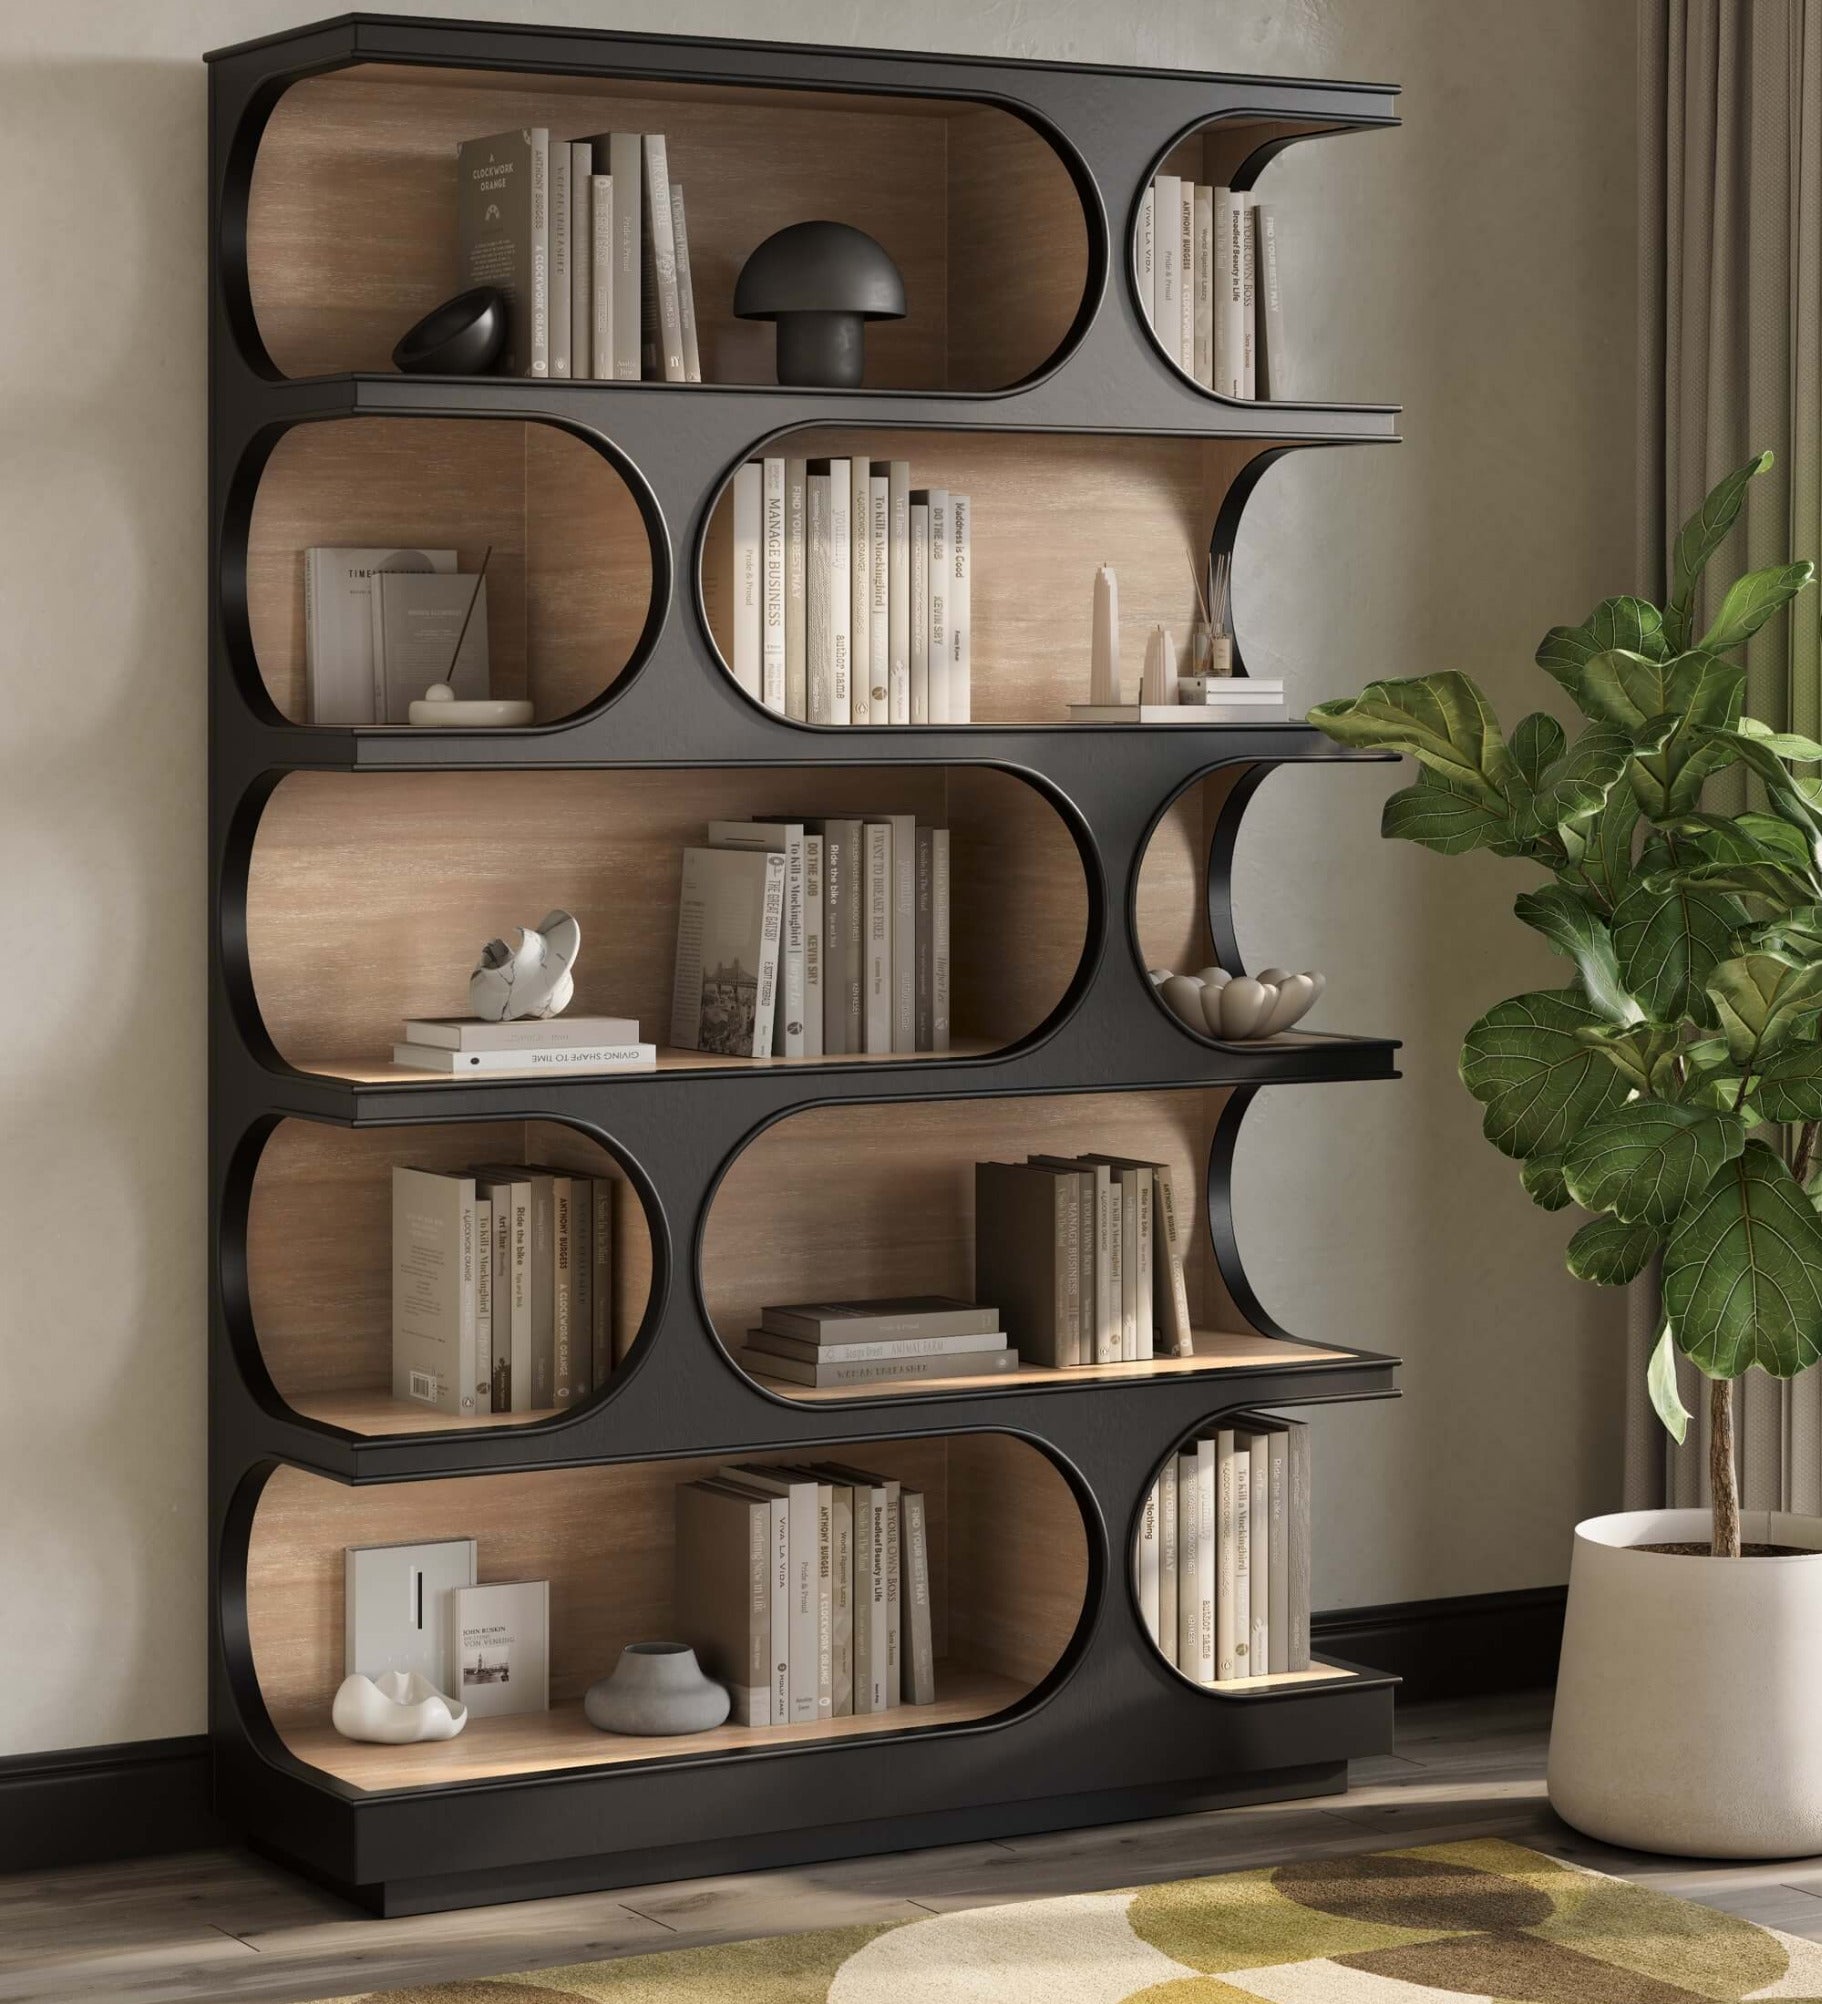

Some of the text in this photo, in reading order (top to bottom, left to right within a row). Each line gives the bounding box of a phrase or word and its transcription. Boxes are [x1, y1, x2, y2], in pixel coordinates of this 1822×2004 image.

[472, 163, 514, 180] CLOCKWORK
[489, 153, 495, 163] A
[480, 178, 506, 192] ORANGE
[535, 150, 544, 230] ANTHONY BURGESS
[1232, 210, 1240, 248] Broadleaf
[1243, 211, 1253, 223] BE
[1183, 201, 1191, 270] ANTHONY BURGESS
[1243, 225, 1253, 250] YOUR
[1231, 250, 1240, 276] Beauty
[1243, 253, 1253, 280] OWN
[535, 255, 544, 309] CLOCKWORK
[535, 313, 544, 348] ORANGE
[792, 486, 802, 510] FIND
[875, 496, 886, 509] To
[768, 498, 781, 557] MANAGE
[792, 512, 802, 541] YOUR
[934, 522, 943, 540] THE
[955, 503, 964, 544] Maddness
[874, 541, 886, 606] Mockingbird
[955, 555, 964, 578] Good
[768, 562, 781, 627] BUSINESS
[835, 635, 846, 699] author name
[791, 842, 801, 854] To
[790, 856, 801, 874] Kill
[808, 843, 818, 896] DO THE JOB
[830, 844, 839, 905] Ride the bike
[873, 863, 884, 876] TO
[763, 880, 781, 942] THE GREAT GATSBY
[789, 884, 801, 946] Mockingbird
[873, 916, 884, 941] FREE
[808, 934, 818, 964] KEVIN
[531, 1051, 640, 1064] GIVING SHAPE TO TIME
[480, 1216, 488, 1229] To
[1163, 1184, 1176, 1242] ANTHONY BURGESS
[516, 1207, 525, 1265] Ride the bike
[559, 1198, 567, 1269] ANTHONY BURGESS
[1068, 1202, 1077, 1295] MANAGE BUSINESS
[479, 1256, 489, 1312] Mockingbird
[559, 1292, 568, 1342] CLOCKWORK
[559, 1345, 568, 1376] ORANGE
[1238, 1469, 1246, 1481] To
[1273, 1458, 1281, 1479] Ride
[874, 1507, 883, 1546] Broadleaf
[1145, 1504, 1154, 1540] Nothing
[779, 1545, 786, 1559] LA
[820, 1506, 829, 1577] ANTHONY BURGESS
[840, 1531, 848, 1554] World
[887, 1502, 897, 1602] BE YOUR OWN BOSS
[1236, 1511, 1247, 1570] Mockingbird
[801, 1561, 809, 1581] Pride
[873, 1547, 882, 1576] Beauty
[801, 1591, 809, 1613] Proud
[874, 1587, 883, 1602] Life
[820, 1600, 829, 1652] CLOCKWORK
